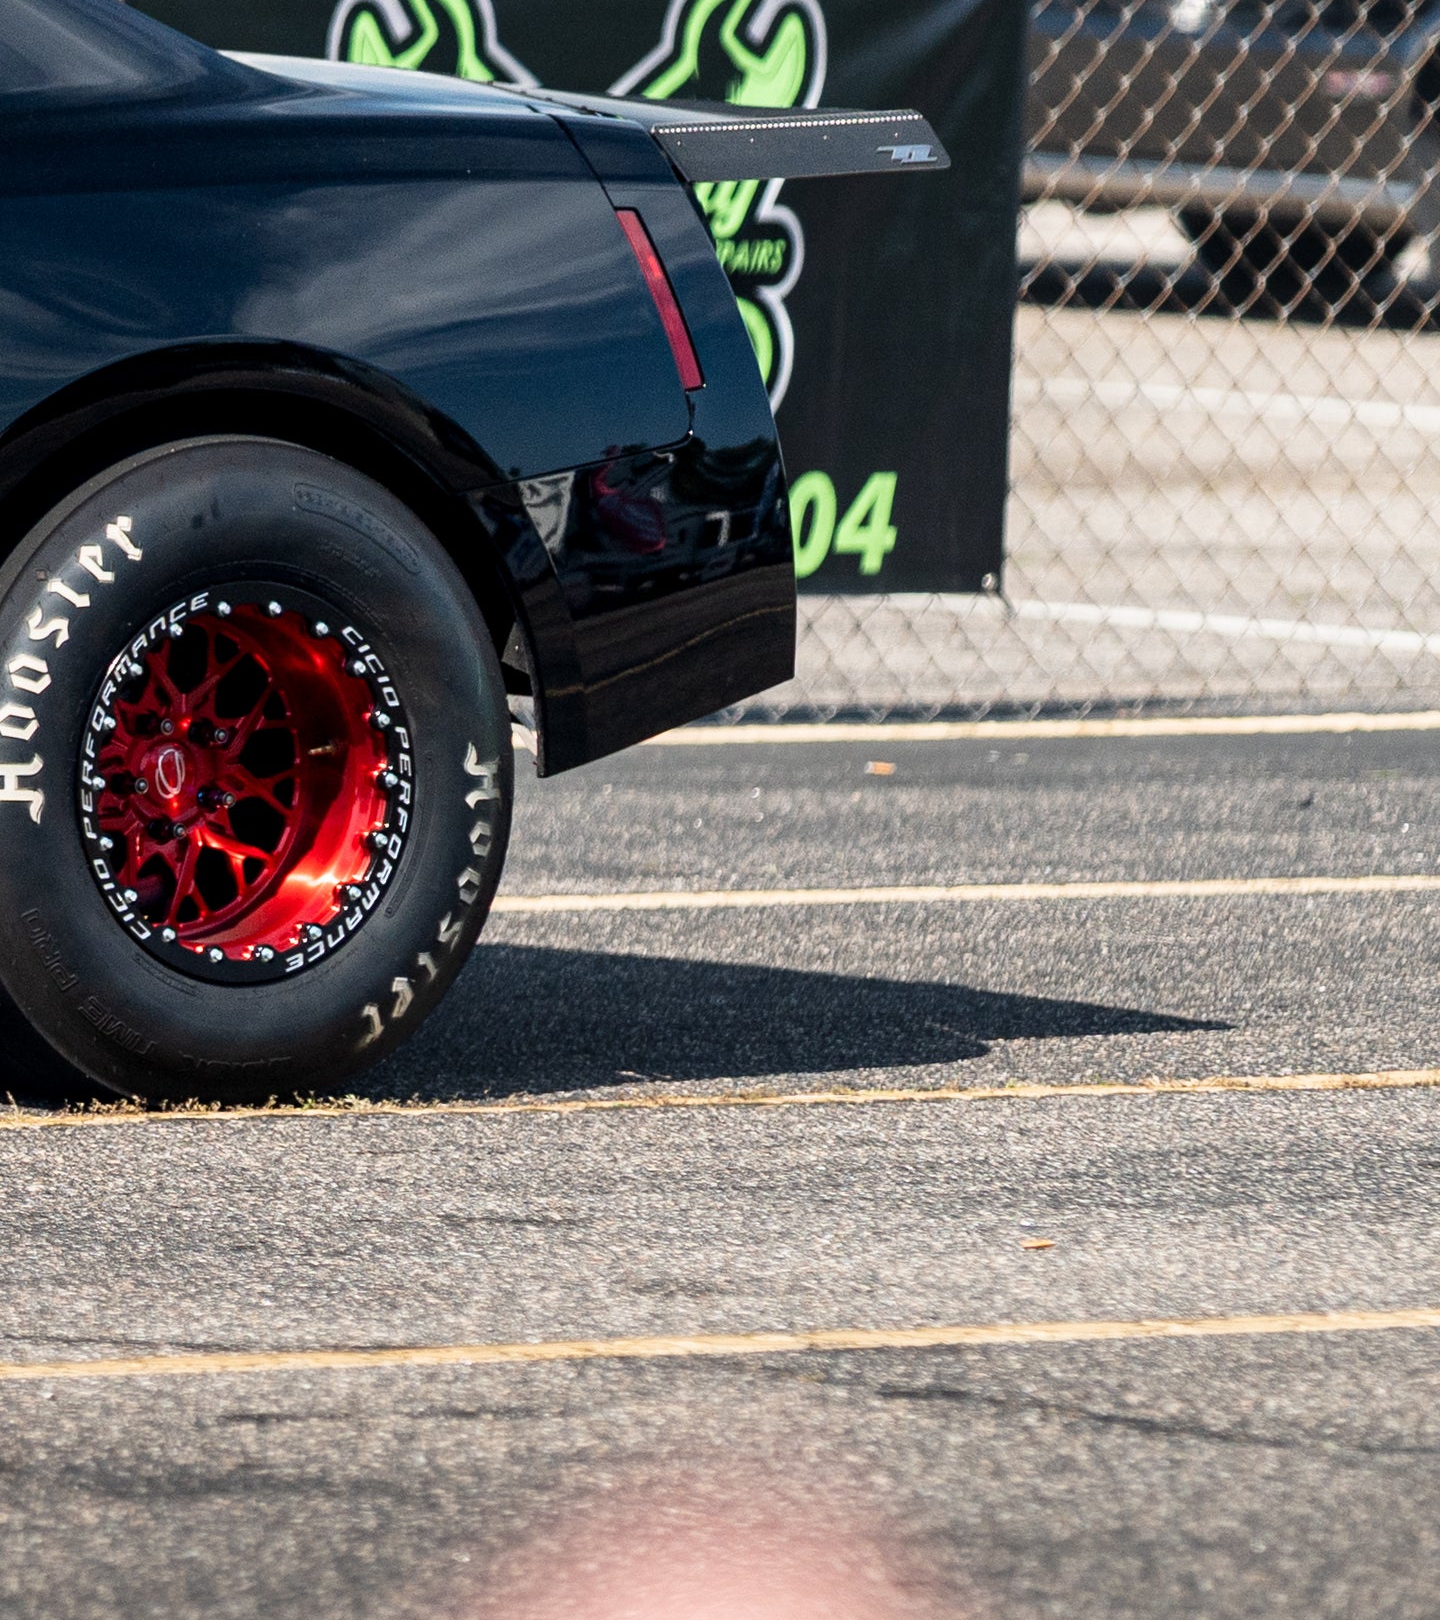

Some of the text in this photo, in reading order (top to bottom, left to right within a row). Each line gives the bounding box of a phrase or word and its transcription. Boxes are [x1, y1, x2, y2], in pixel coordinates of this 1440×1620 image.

[715, 239, 786, 274] PAIRS
[81, 592, 209, 940] CICIO PERFORMANCE
[341, 626, 399, 708] CICIO
[285, 726, 412, 973] PERFORMANCE
[356, 742, 502, 1052] Hoosier
